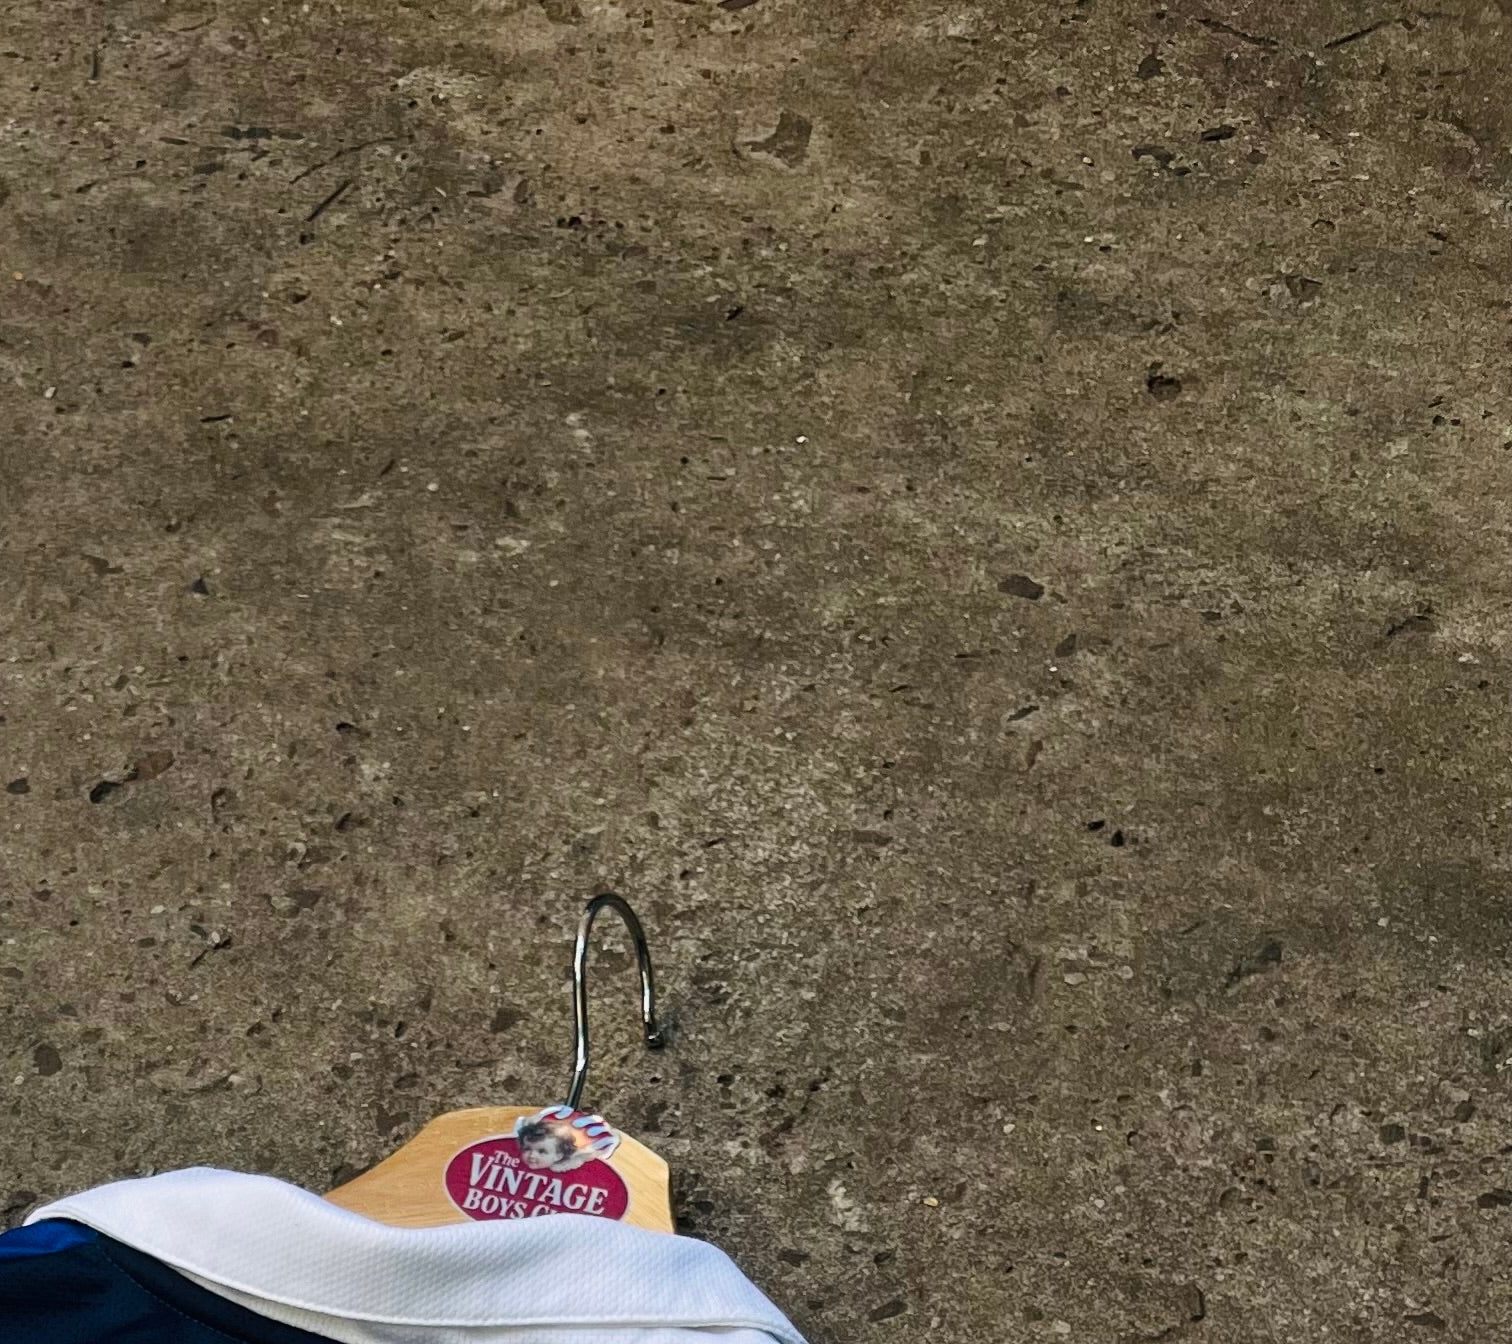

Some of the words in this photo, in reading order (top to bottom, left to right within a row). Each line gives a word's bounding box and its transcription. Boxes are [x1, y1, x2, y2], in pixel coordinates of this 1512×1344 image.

[493, 1150, 520, 1168] The
[469, 1152, 608, 1215] VINTAGE
[462, 1187, 528, 1219] BOYS
